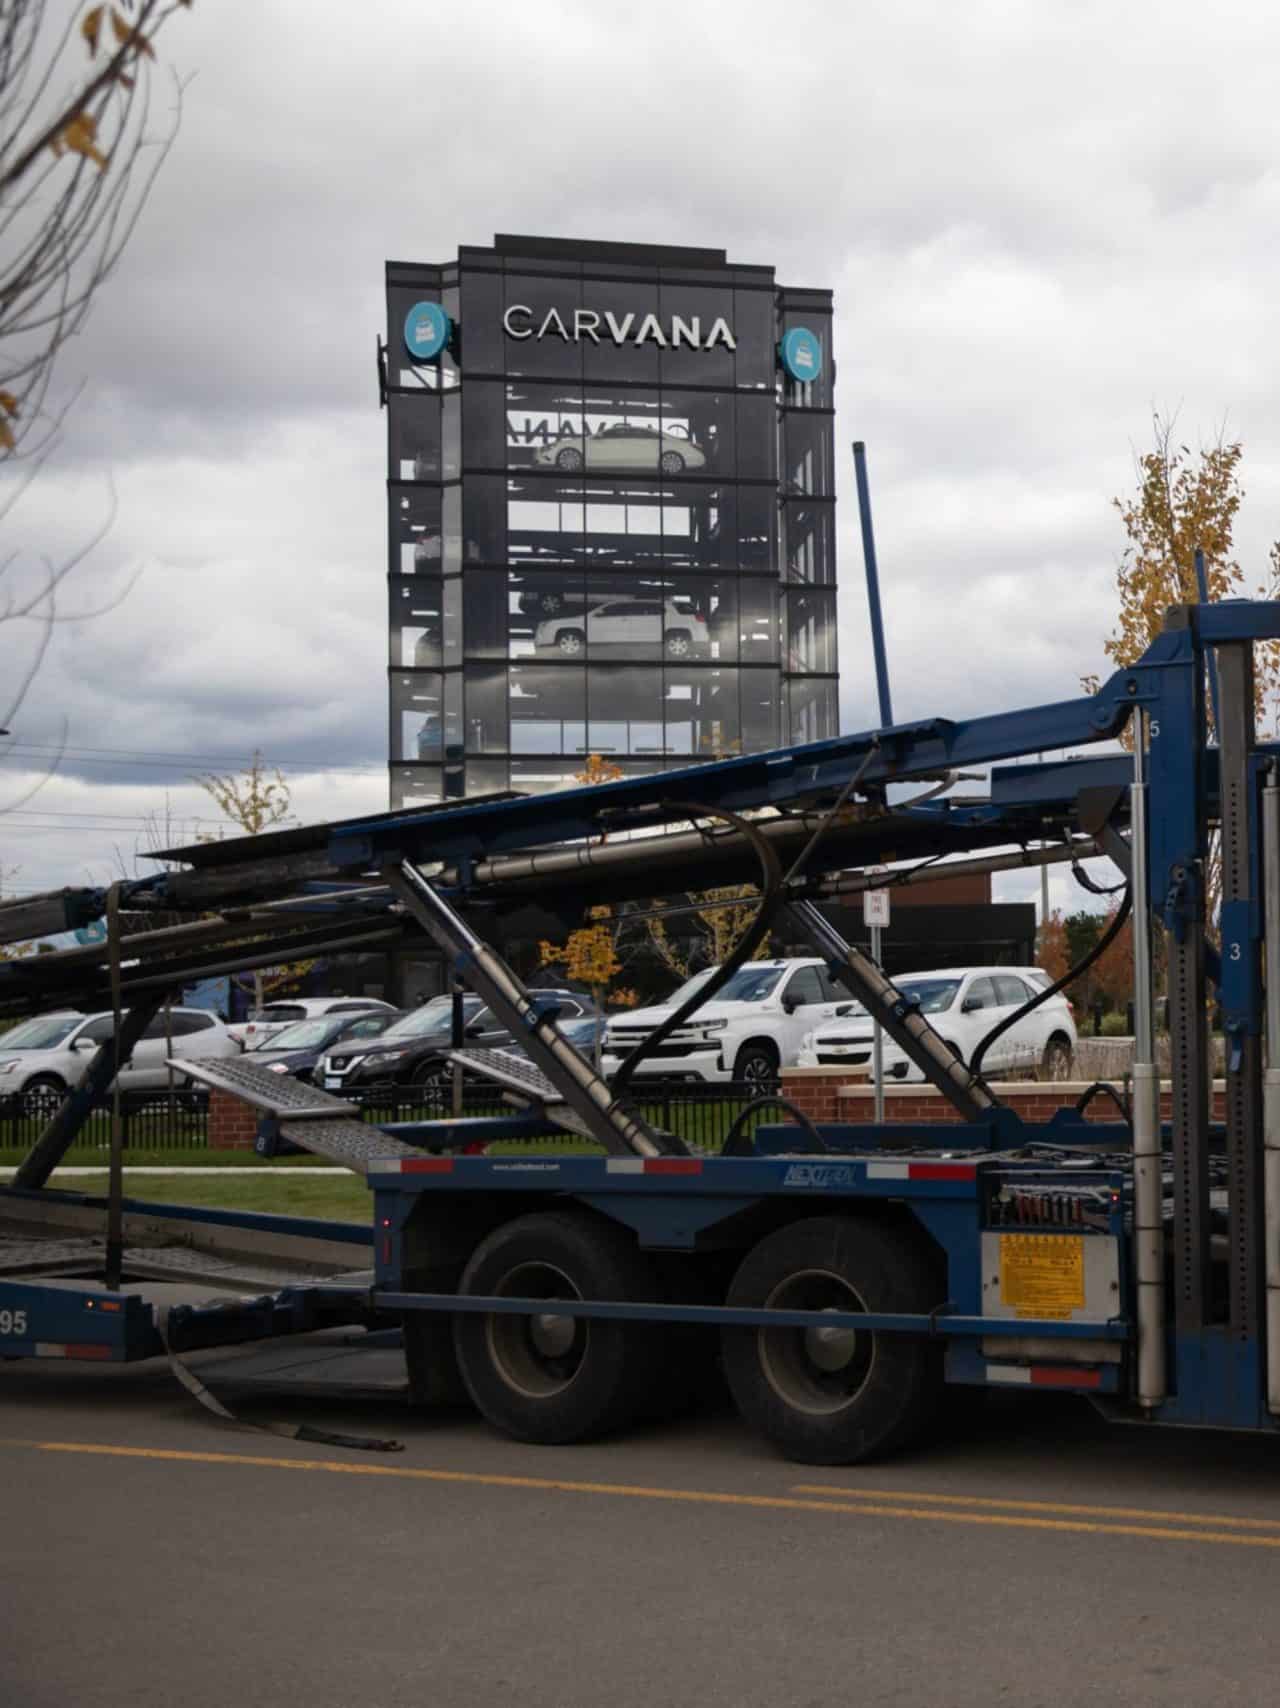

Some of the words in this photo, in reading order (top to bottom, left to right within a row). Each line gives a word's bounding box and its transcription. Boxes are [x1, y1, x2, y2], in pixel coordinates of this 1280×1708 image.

[503, 304, 737, 350] CARVANA
[1150, 719, 1161, 738] 5
[1230, 943, 1241, 961] 3
